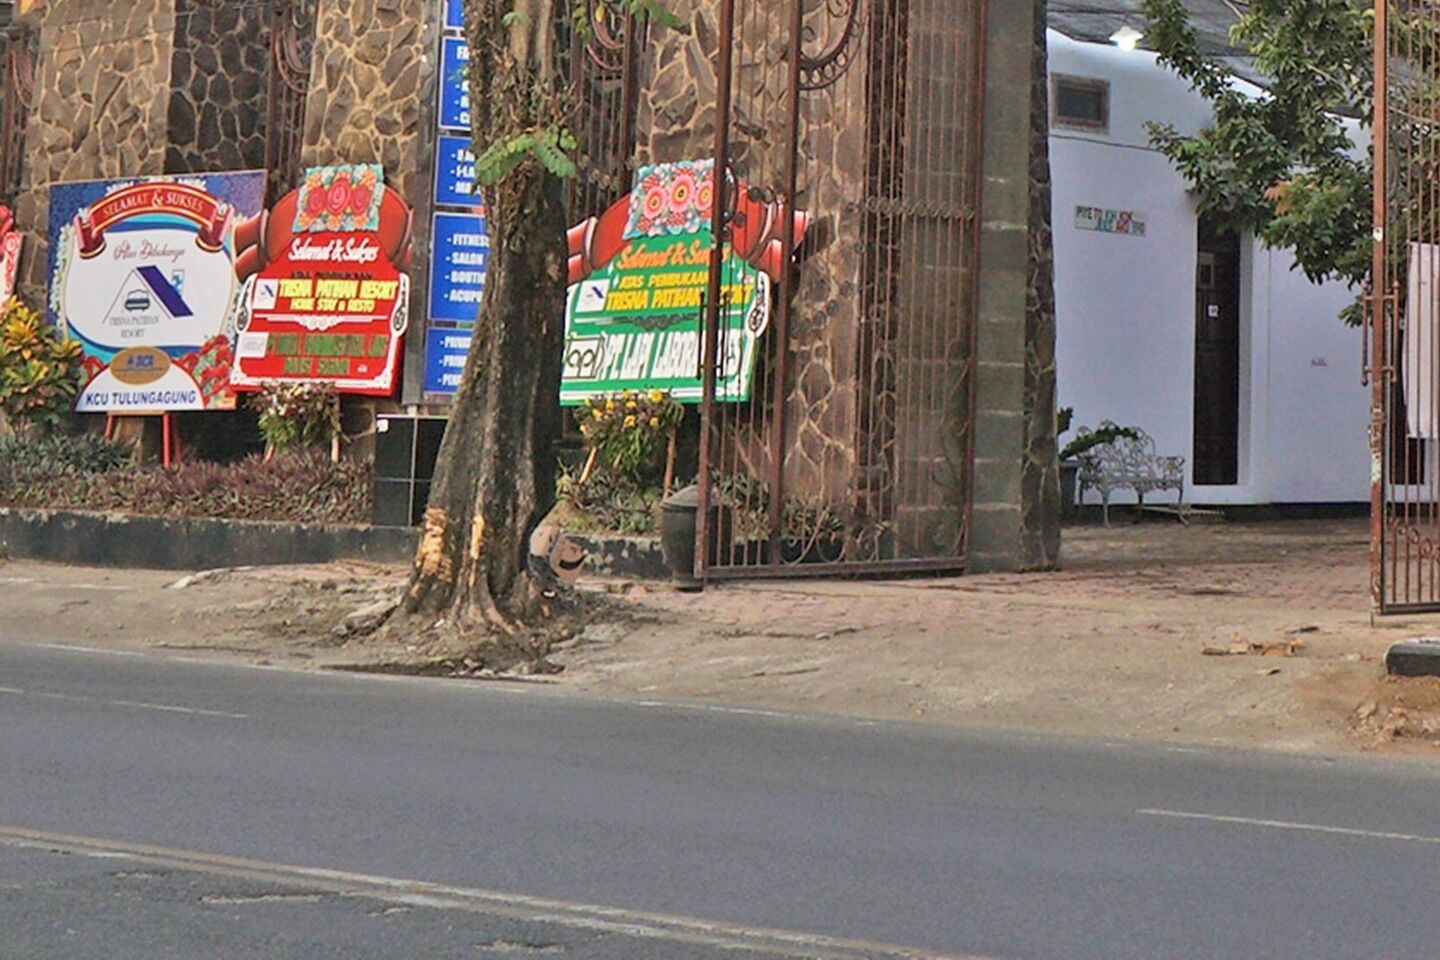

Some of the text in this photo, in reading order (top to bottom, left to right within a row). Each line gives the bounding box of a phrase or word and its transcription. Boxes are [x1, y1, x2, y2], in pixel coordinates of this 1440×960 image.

[103, 190, 204, 216] SELAMAT & SUKSES
[451, 252, 484, 265] SALON
[616, 243, 670, 270] Selamat
[359, 280, 398, 300] RESORT
[606, 289, 648, 311] TRISNA
[85, 390, 197, 406] KCU TULUNGAGUNG
